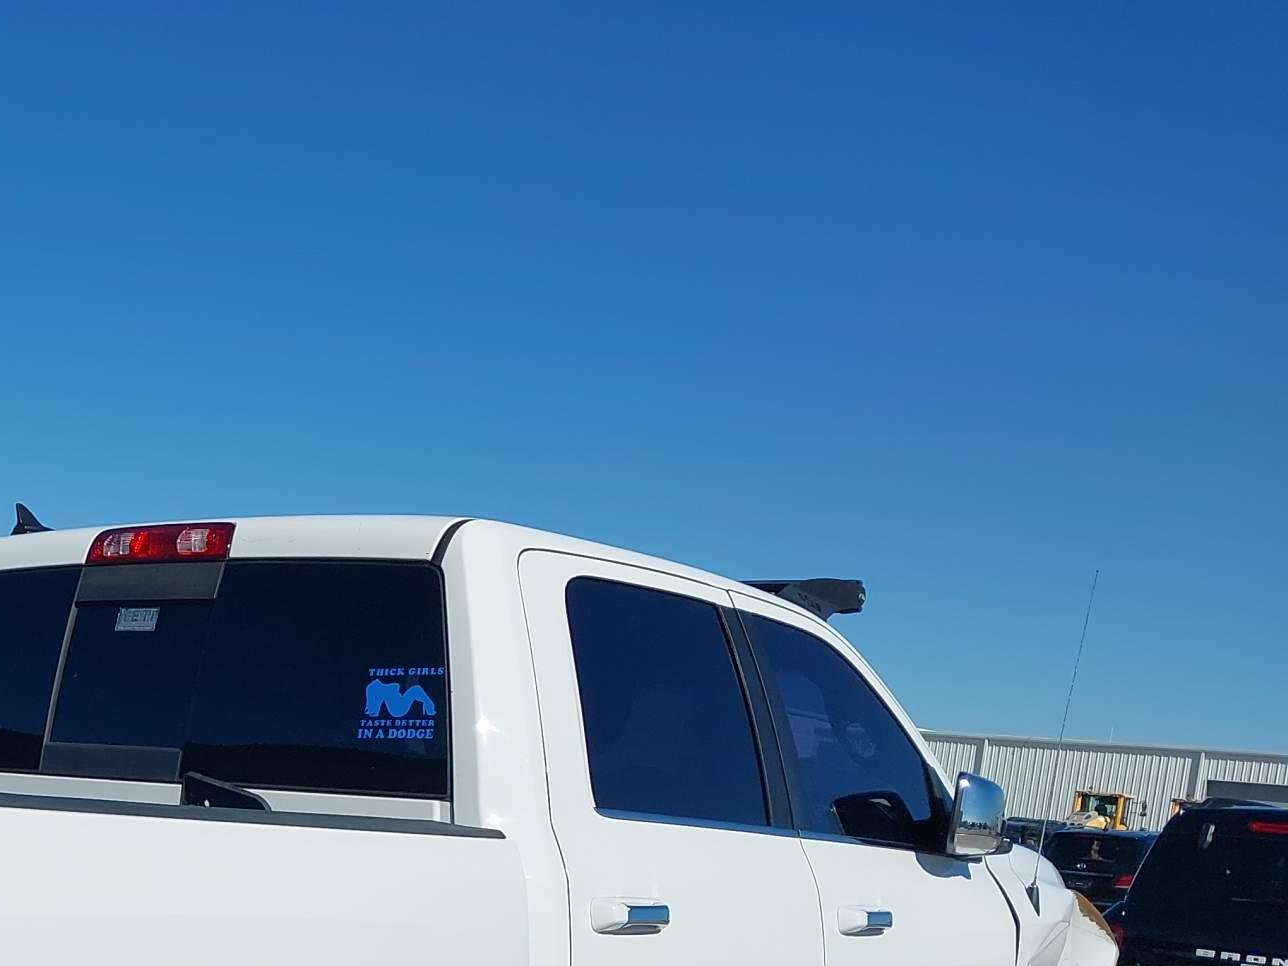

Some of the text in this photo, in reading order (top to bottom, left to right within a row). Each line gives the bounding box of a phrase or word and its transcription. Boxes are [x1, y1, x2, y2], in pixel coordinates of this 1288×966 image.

[369, 667, 444, 676] THICK GIRLS
[360, 719, 434, 727] TASTE BETTER
[357, 729, 434, 739] IN A DODGE
